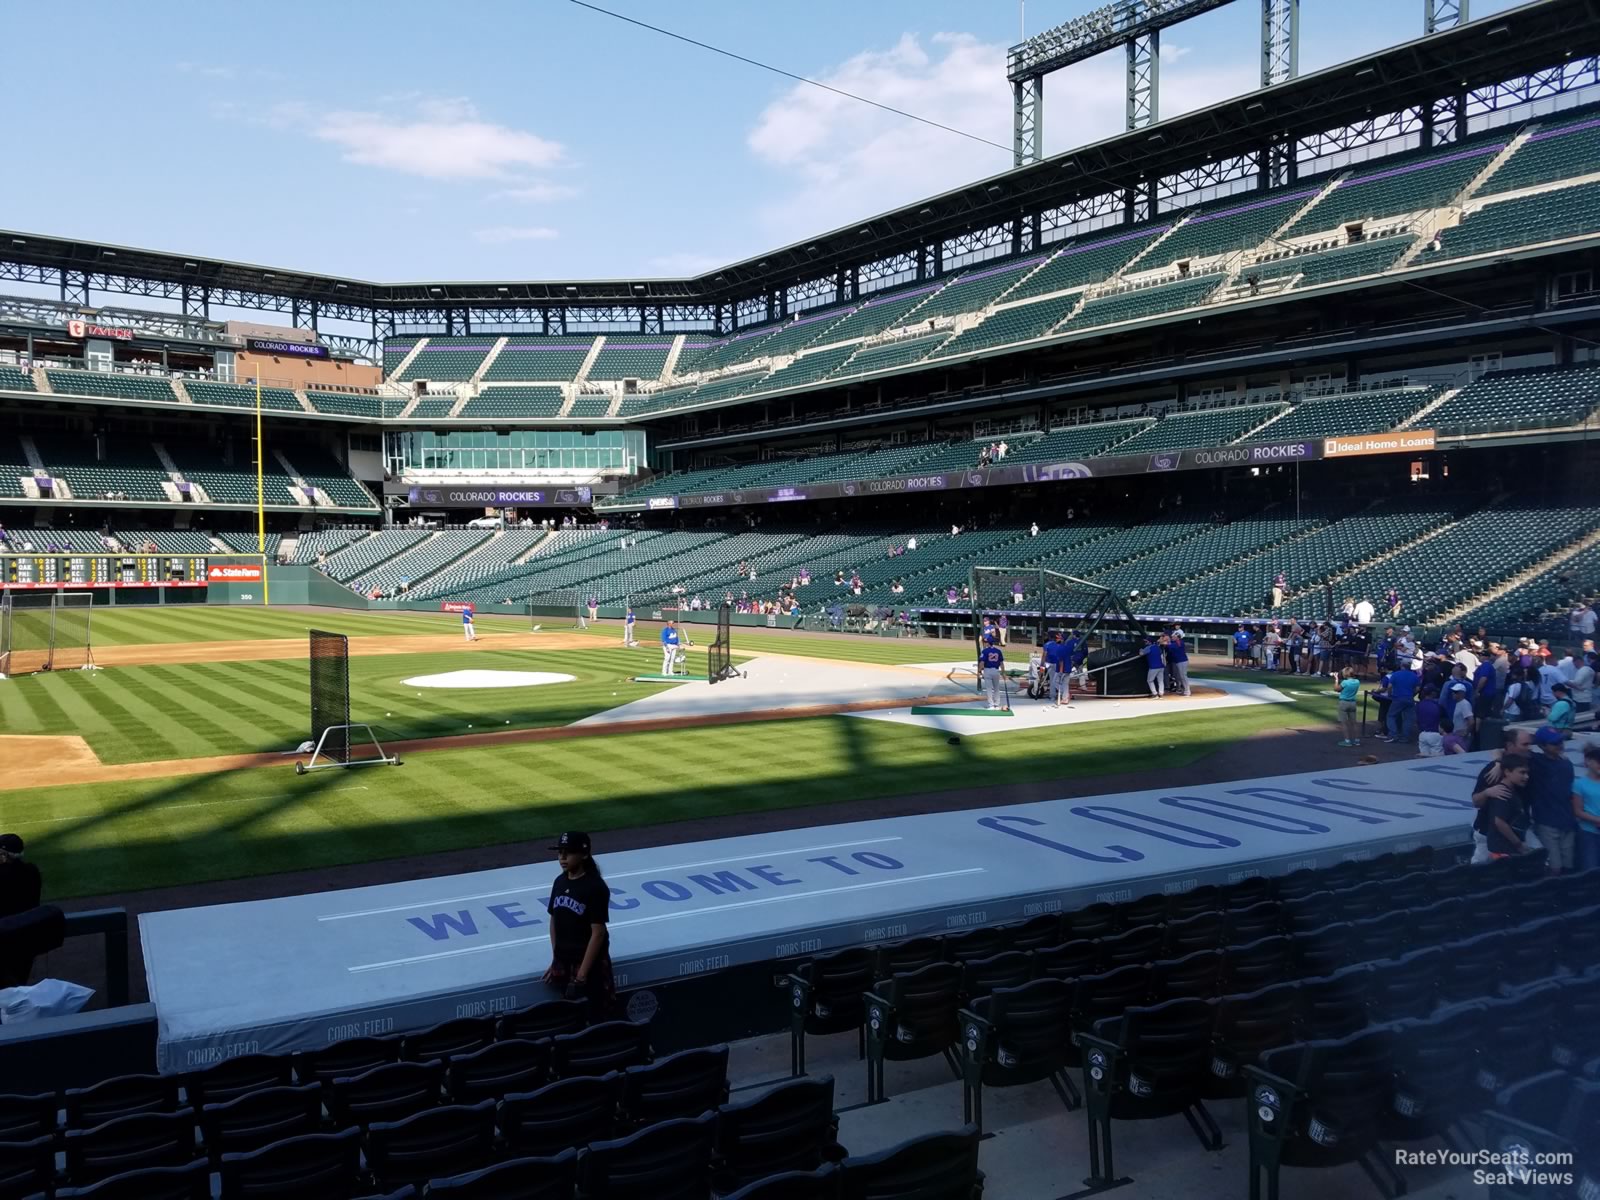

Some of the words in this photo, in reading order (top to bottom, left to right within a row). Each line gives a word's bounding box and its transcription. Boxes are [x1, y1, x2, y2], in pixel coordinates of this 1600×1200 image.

[253, 341, 288, 351] COLORADO
[289, 344, 319, 354] ROCKIES
[1195, 448, 1250, 464] COLORADO
[1253, 443, 1305, 460] ROCKIES
[1337, 442, 1363, 452] Ideal
[1365, 439, 1397, 450] Home
[1400, 437, 1435, 448] Loans
[870, 480, 906, 492] COLORADO
[908, 476, 943, 488] ROCKIES
[450, 491, 496, 501] COLORADO
[499, 491, 540, 501] ROCKIES
[703, 495, 724, 504] ROCKIES
[977, 778, 1477, 863] COORS
[407, 864, 803, 941] WECOME
[808, 851, 905, 876] TO
[1164, 881, 1182, 894] COORS
[1182, 878, 1198, 892] FIELD
[553, 895, 587, 916] OCKIES
[1024, 902, 1042, 916] COORS
[1043, 899, 1062, 913] FIELD
[946, 913, 967, 928] COORS
[968, 911, 987, 924] FIELD
[864, 927, 886, 942] COORS
[887, 923, 907, 938] FIELD
[776, 943, 798, 959] COORS
[801, 938, 822, 953] FIELD
[680, 960, 704, 976] COORS
[706, 954, 729, 970] FIELD
[456, 1001, 486, 1018] COORS
[489, 995, 517, 1012] FIELD
[327, 1023, 360, 1042] COORS
[364, 1017, 394, 1036] FIELD
[187, 1047, 223, 1066] COORS
[227, 1040, 260, 1059] FIELD
